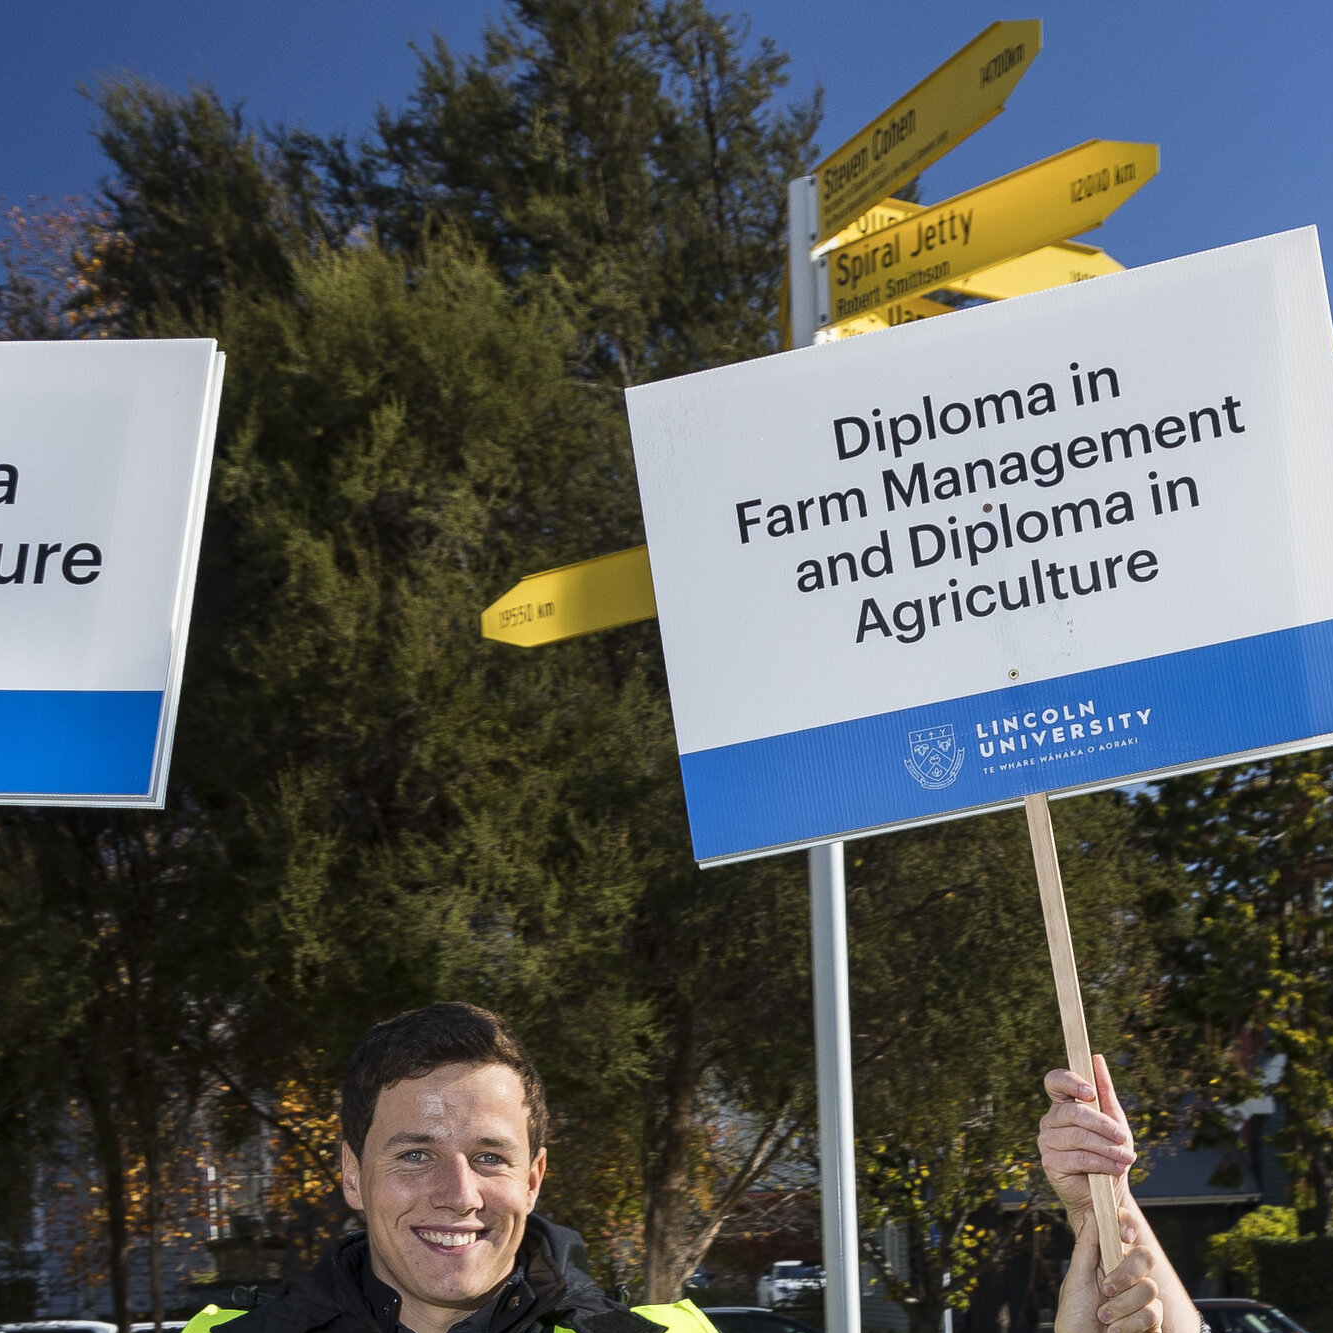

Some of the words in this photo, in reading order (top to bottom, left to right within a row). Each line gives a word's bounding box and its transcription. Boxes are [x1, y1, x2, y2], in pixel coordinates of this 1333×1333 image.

[823, 145, 868, 200] Steven
[872, 108, 916, 161] Cohen
[1114, 163, 1136, 186] km
[836, 233, 901, 289] Spiral
[910, 208, 973, 257] Jetty
[835, 284, 881, 318] Robert
[885, 260, 951, 298] Smithson
[833, 382, 1056, 461] Diploma
[1071, 362, 1120, 407] in
[735, 487, 868, 545] Farm
[881, 394, 1247, 512] Management
[796, 529, 895, 594] and
[908, 491, 1136, 569] Diploma
[1149, 472, 1201, 516] in
[538, 600, 556, 618] km
[854, 549, 1160, 645] Agriculture
[976, 700, 1095, 739] LINCOLN
[980, 708, 1152, 758] UNIVERSITY
[982, 765, 996, 775] TE
[999, 758, 1036, 772] WHARE
[1039, 748, 1083, 765] WĀNAKA
[1087, 746, 1094, 754] O
[1098, 737, 1139, 752] AORAKI
